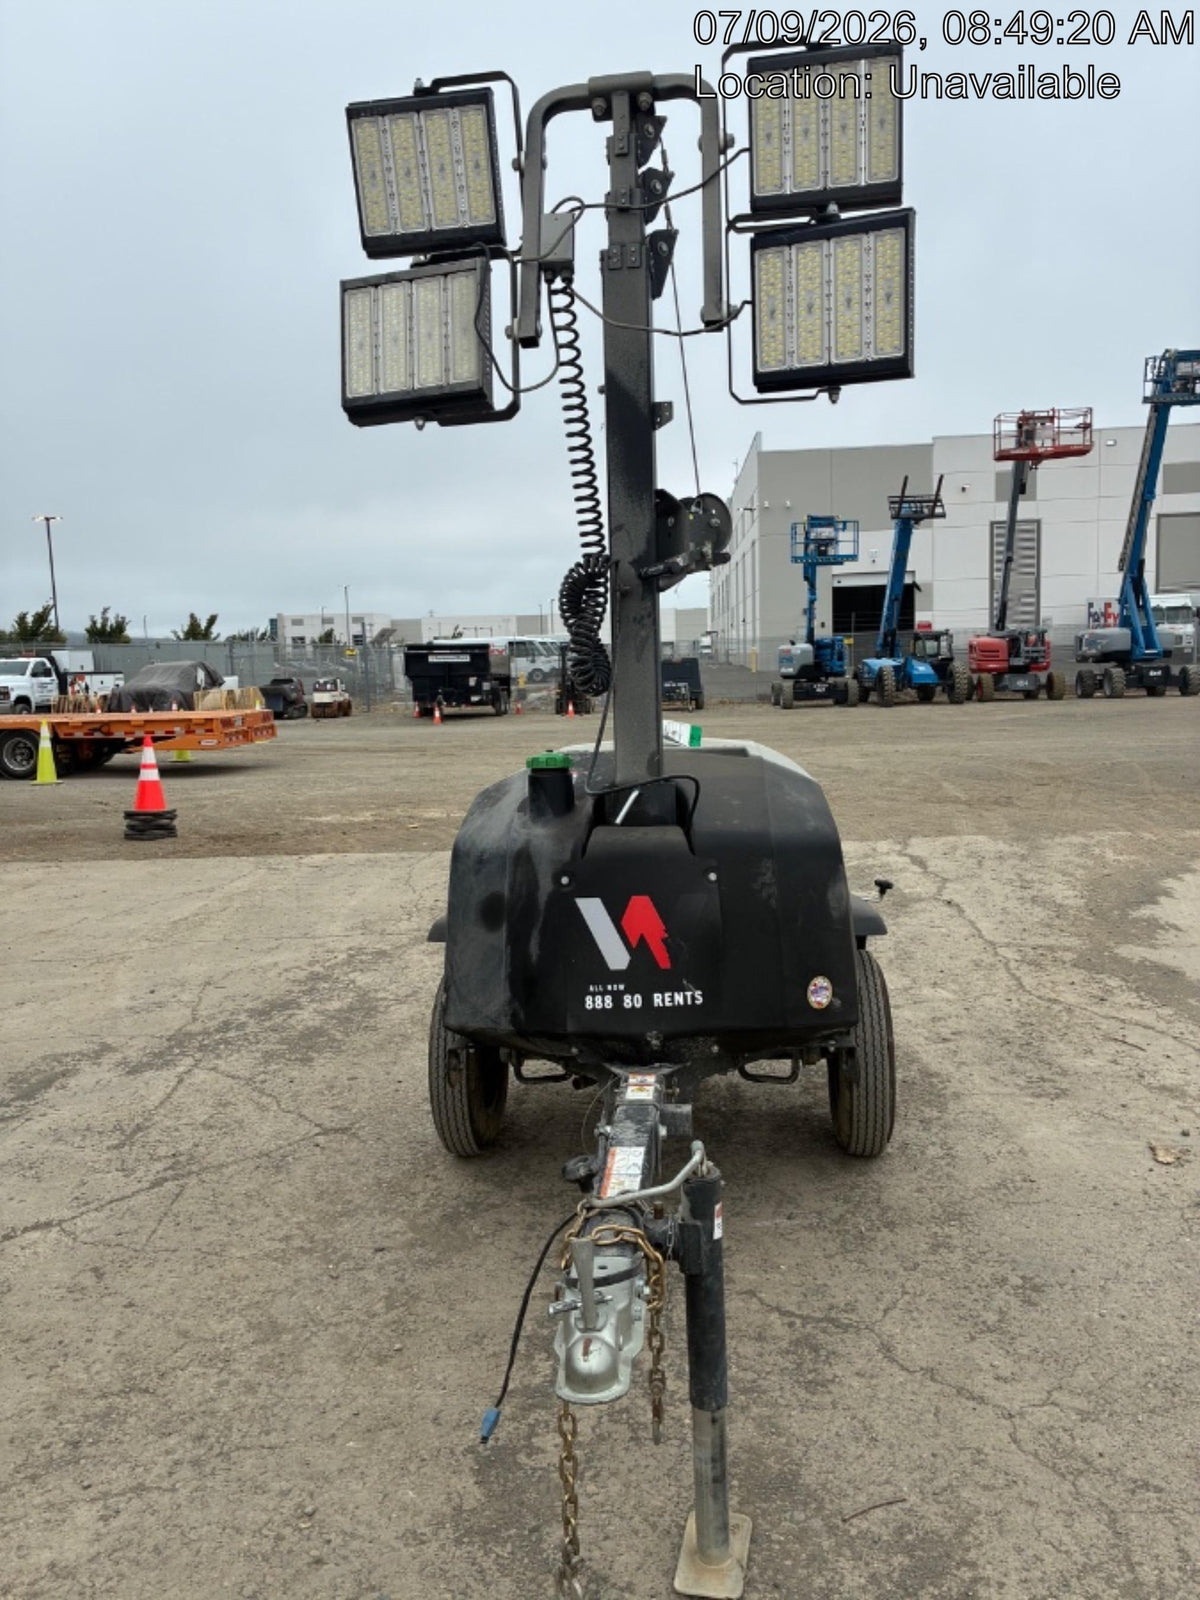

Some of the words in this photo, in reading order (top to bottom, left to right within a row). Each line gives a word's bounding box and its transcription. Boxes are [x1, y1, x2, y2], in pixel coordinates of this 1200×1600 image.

[585, 995, 613, 1010] 888
[623, 994, 643, 1009] 80
[653, 990, 703, 1007] RENTS
